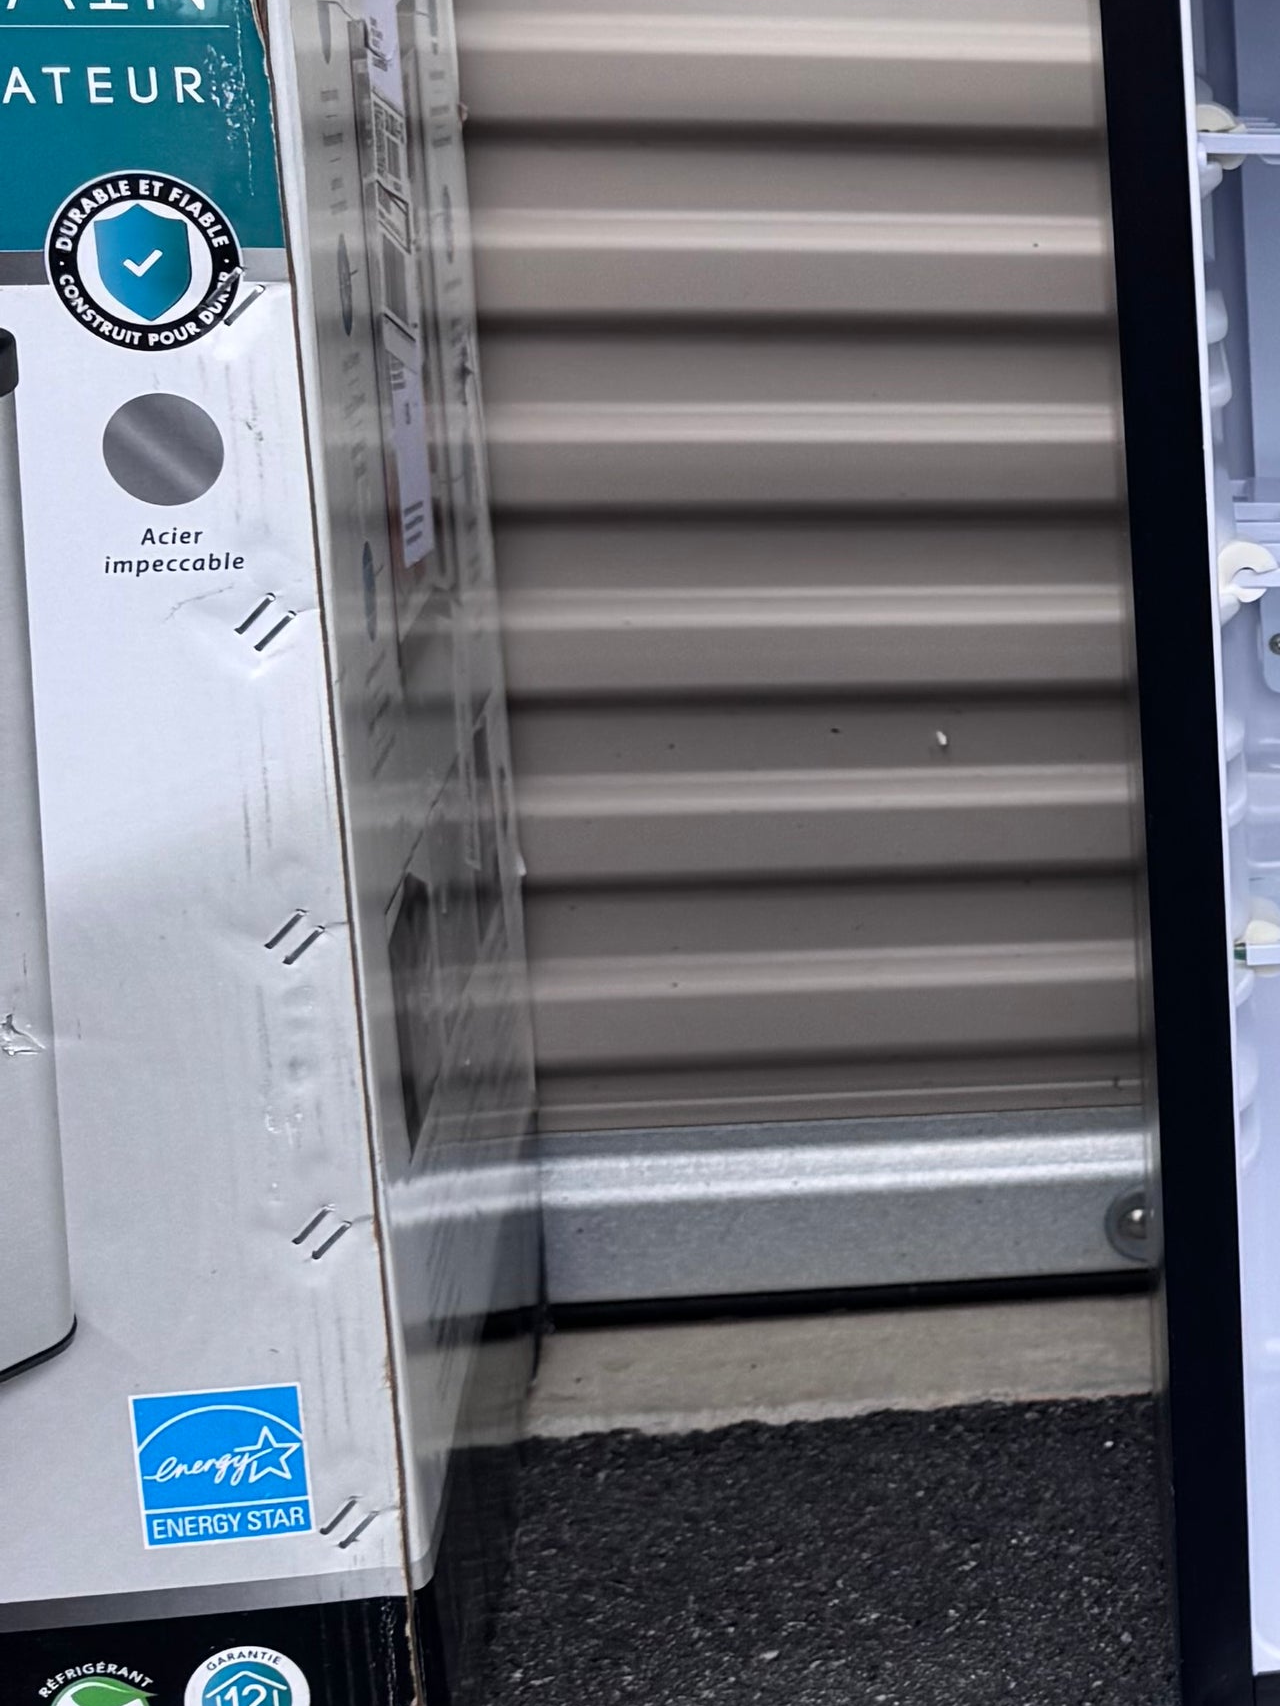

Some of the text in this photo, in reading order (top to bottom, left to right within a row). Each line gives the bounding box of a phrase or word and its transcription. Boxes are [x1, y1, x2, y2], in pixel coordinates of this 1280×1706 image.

[2, 66, 205, 104] ATEUR
[55, 179, 230, 253] DURABLE ET FIABLE
[59, 274, 143, 345] CONSTRUIT
[148, 321, 201, 346] POUR
[140, 527, 204, 545] Acier
[104, 552, 245, 577] impeccable
[143, 1449, 256, 1487] energy
[152, 1506, 305, 1540] ENERGY STAR
[205, 1649, 283, 1672] GARANTIE
[38, 1661, 154, 1699] RÉFRIGÉRANT
